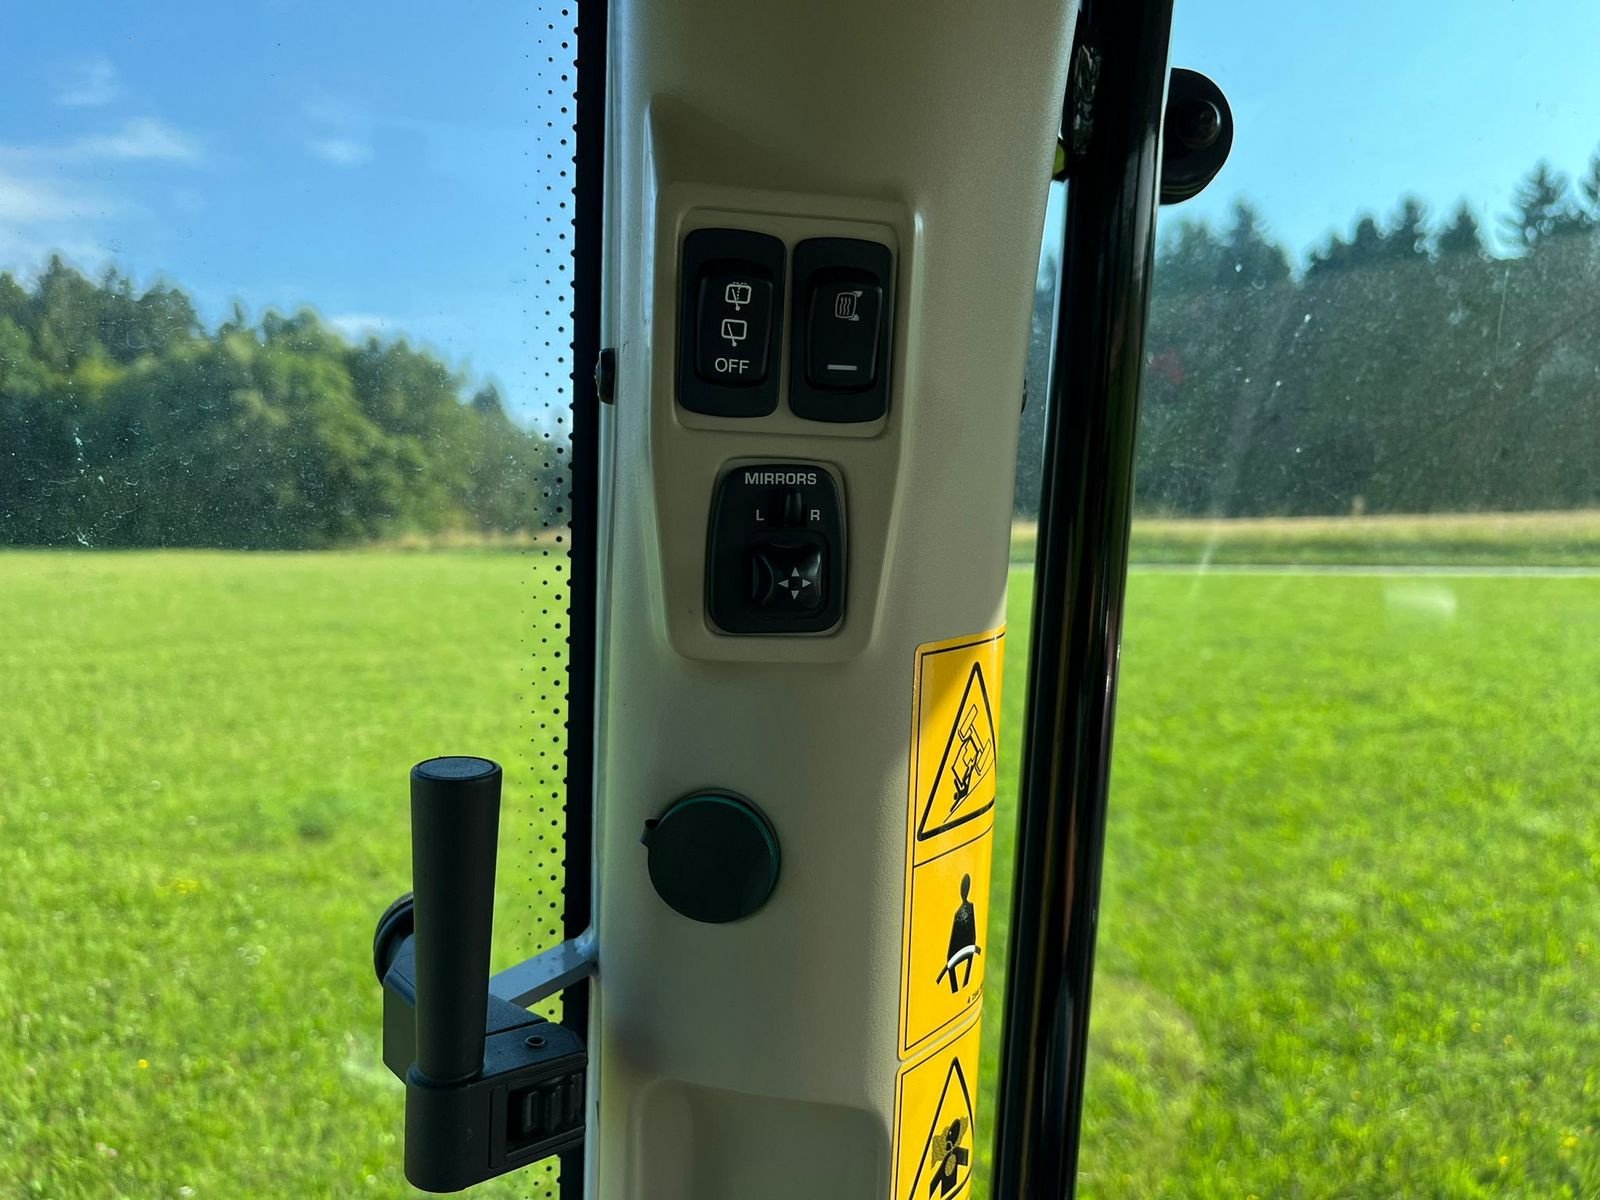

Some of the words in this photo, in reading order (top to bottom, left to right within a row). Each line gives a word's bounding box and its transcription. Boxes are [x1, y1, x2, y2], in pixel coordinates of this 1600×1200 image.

[715, 358, 750, 374] OFF
[745, 473, 817, 485] MIRRORS
[756, 510, 765, 521] L
[810, 510, 821, 521] R
